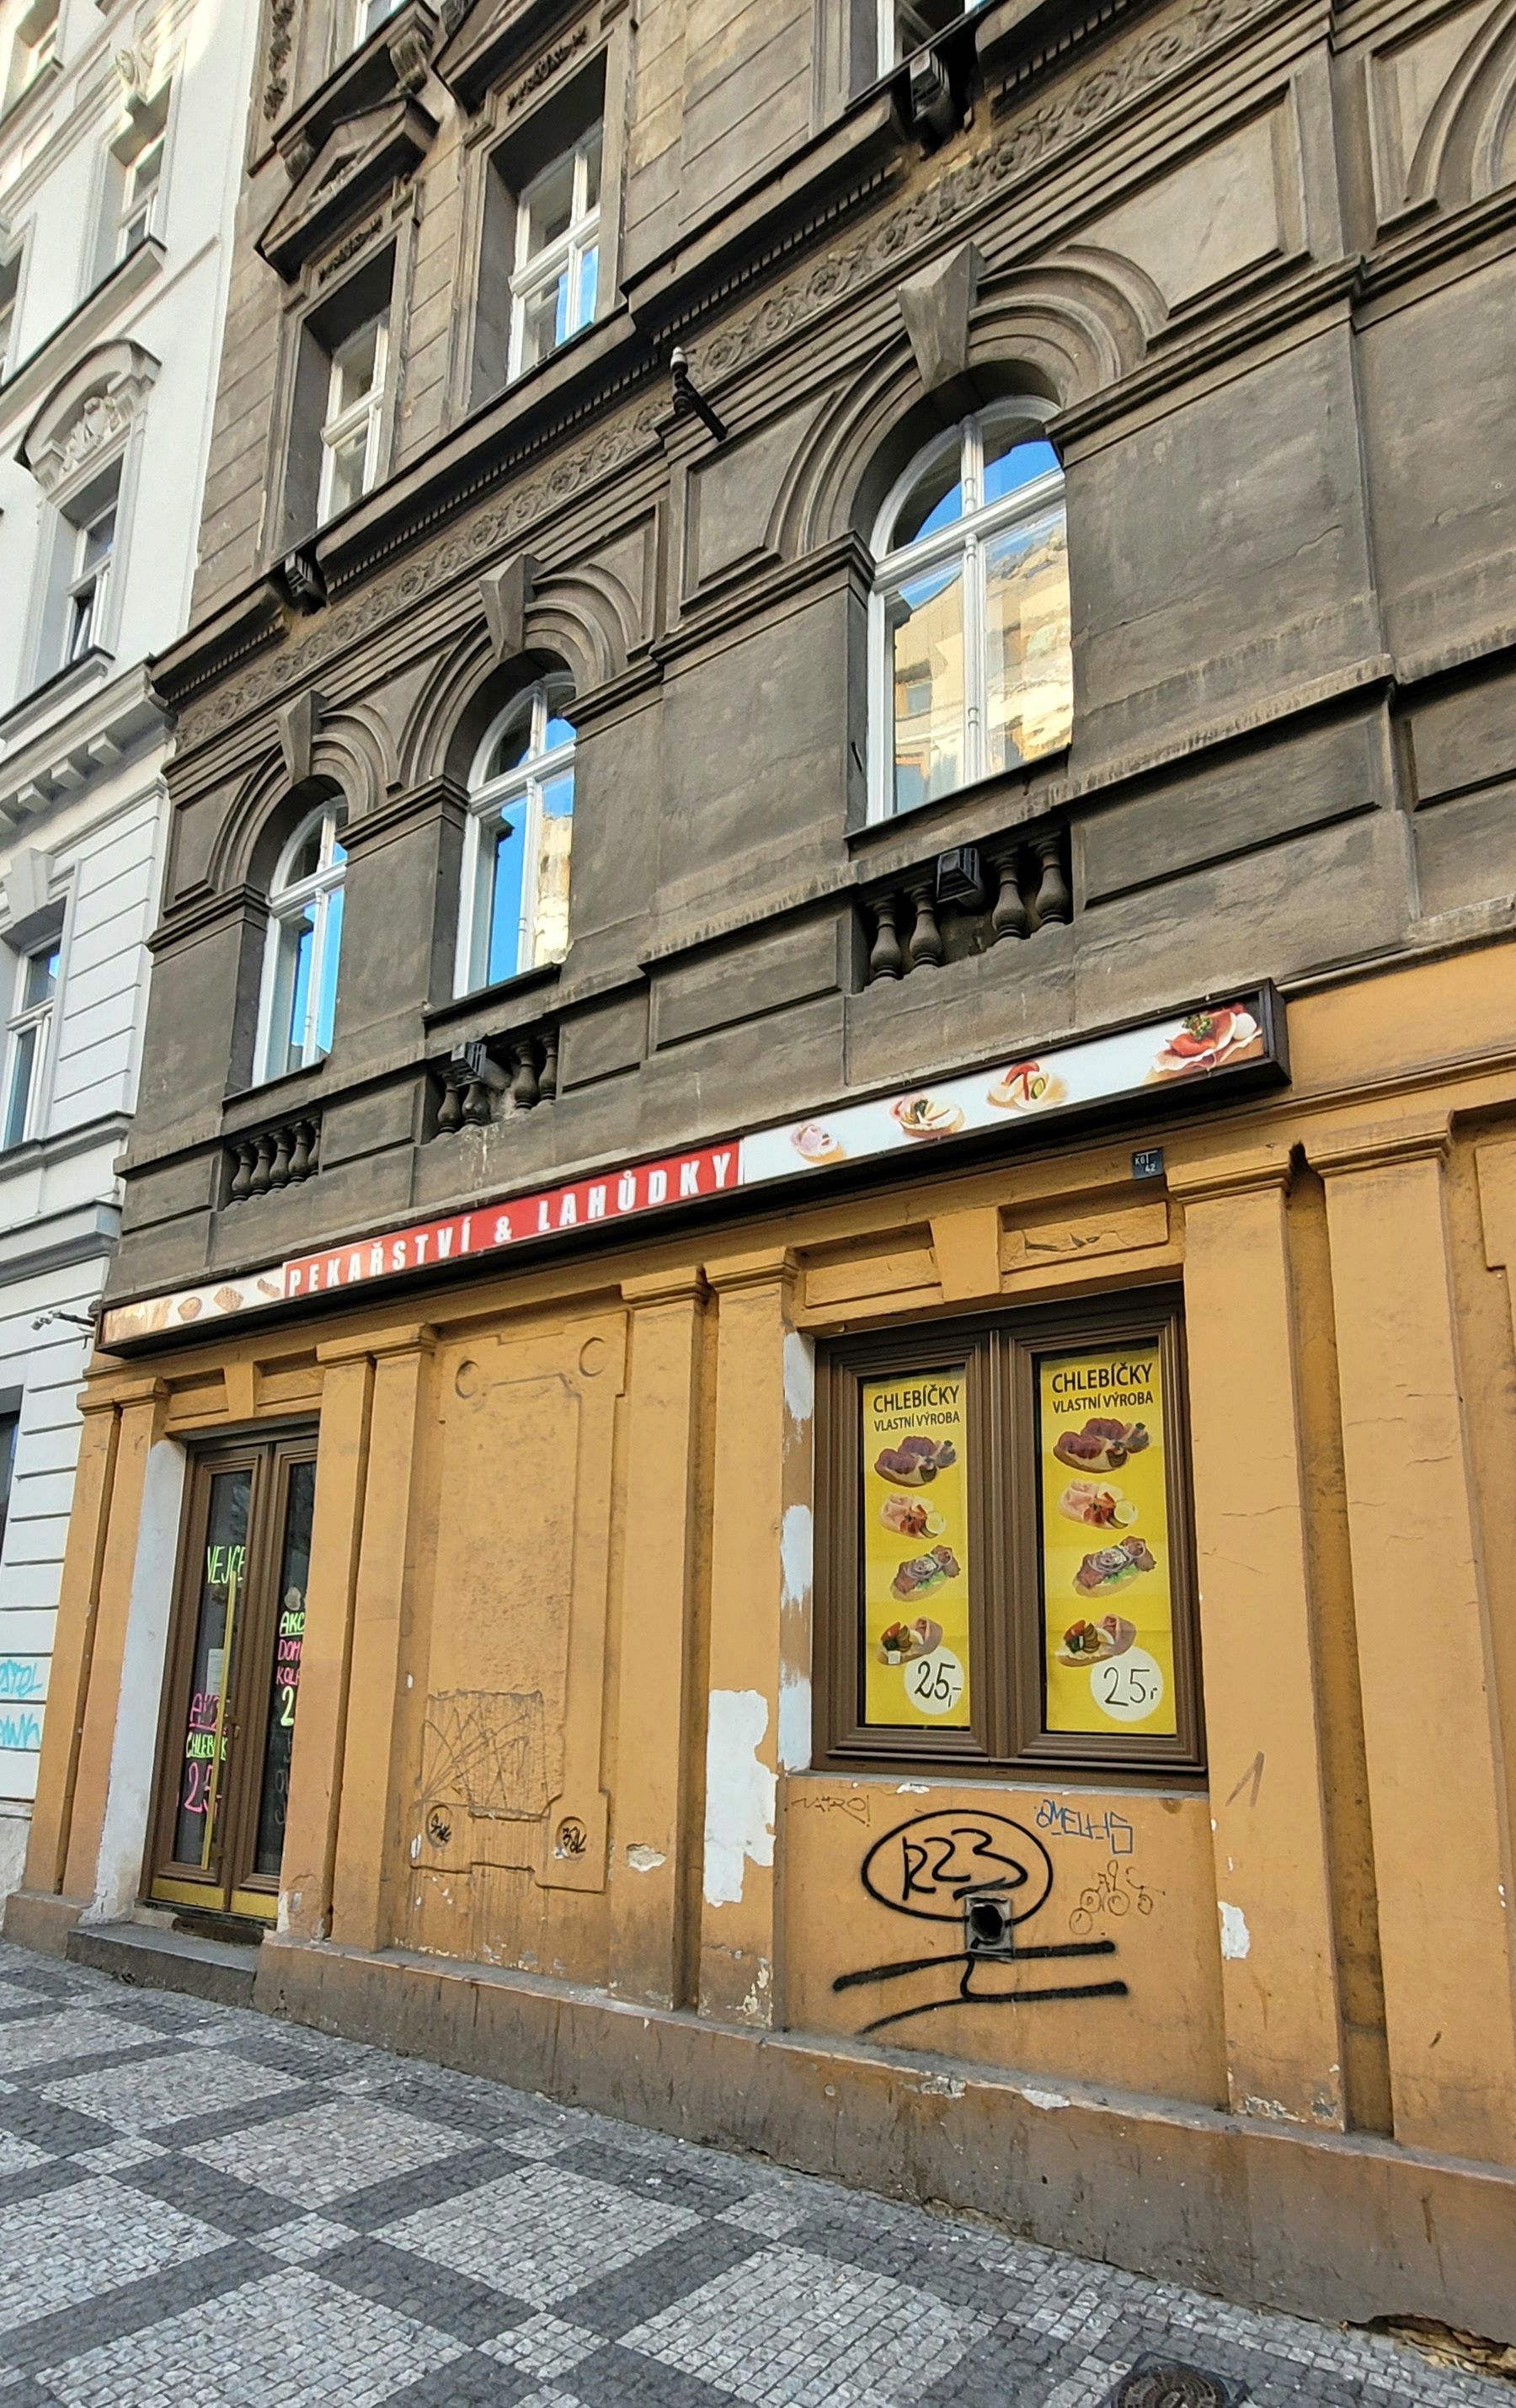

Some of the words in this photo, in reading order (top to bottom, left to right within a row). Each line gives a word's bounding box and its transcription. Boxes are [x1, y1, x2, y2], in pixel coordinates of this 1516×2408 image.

[289, 1216, 472, 1298] PEKAŘSTVÍ
[494, 1215, 512, 1244] &
[537, 1152, 731, 1231] LAHŮDKY
[1051, 1362, 1153, 1393] CHLEBÍČKY
[873, 1384, 959, 1413] CHLEBÍČKY
[1053, 1393, 1102, 1413] VLASTNÍ
[1102, 1391, 1154, 1409] VÝROBA
[873, 1413, 915, 1432] VLASTNÍ
[915, 1411, 960, 1427] VÝROBA
[207, 1545, 246, 1583] VEJCE
